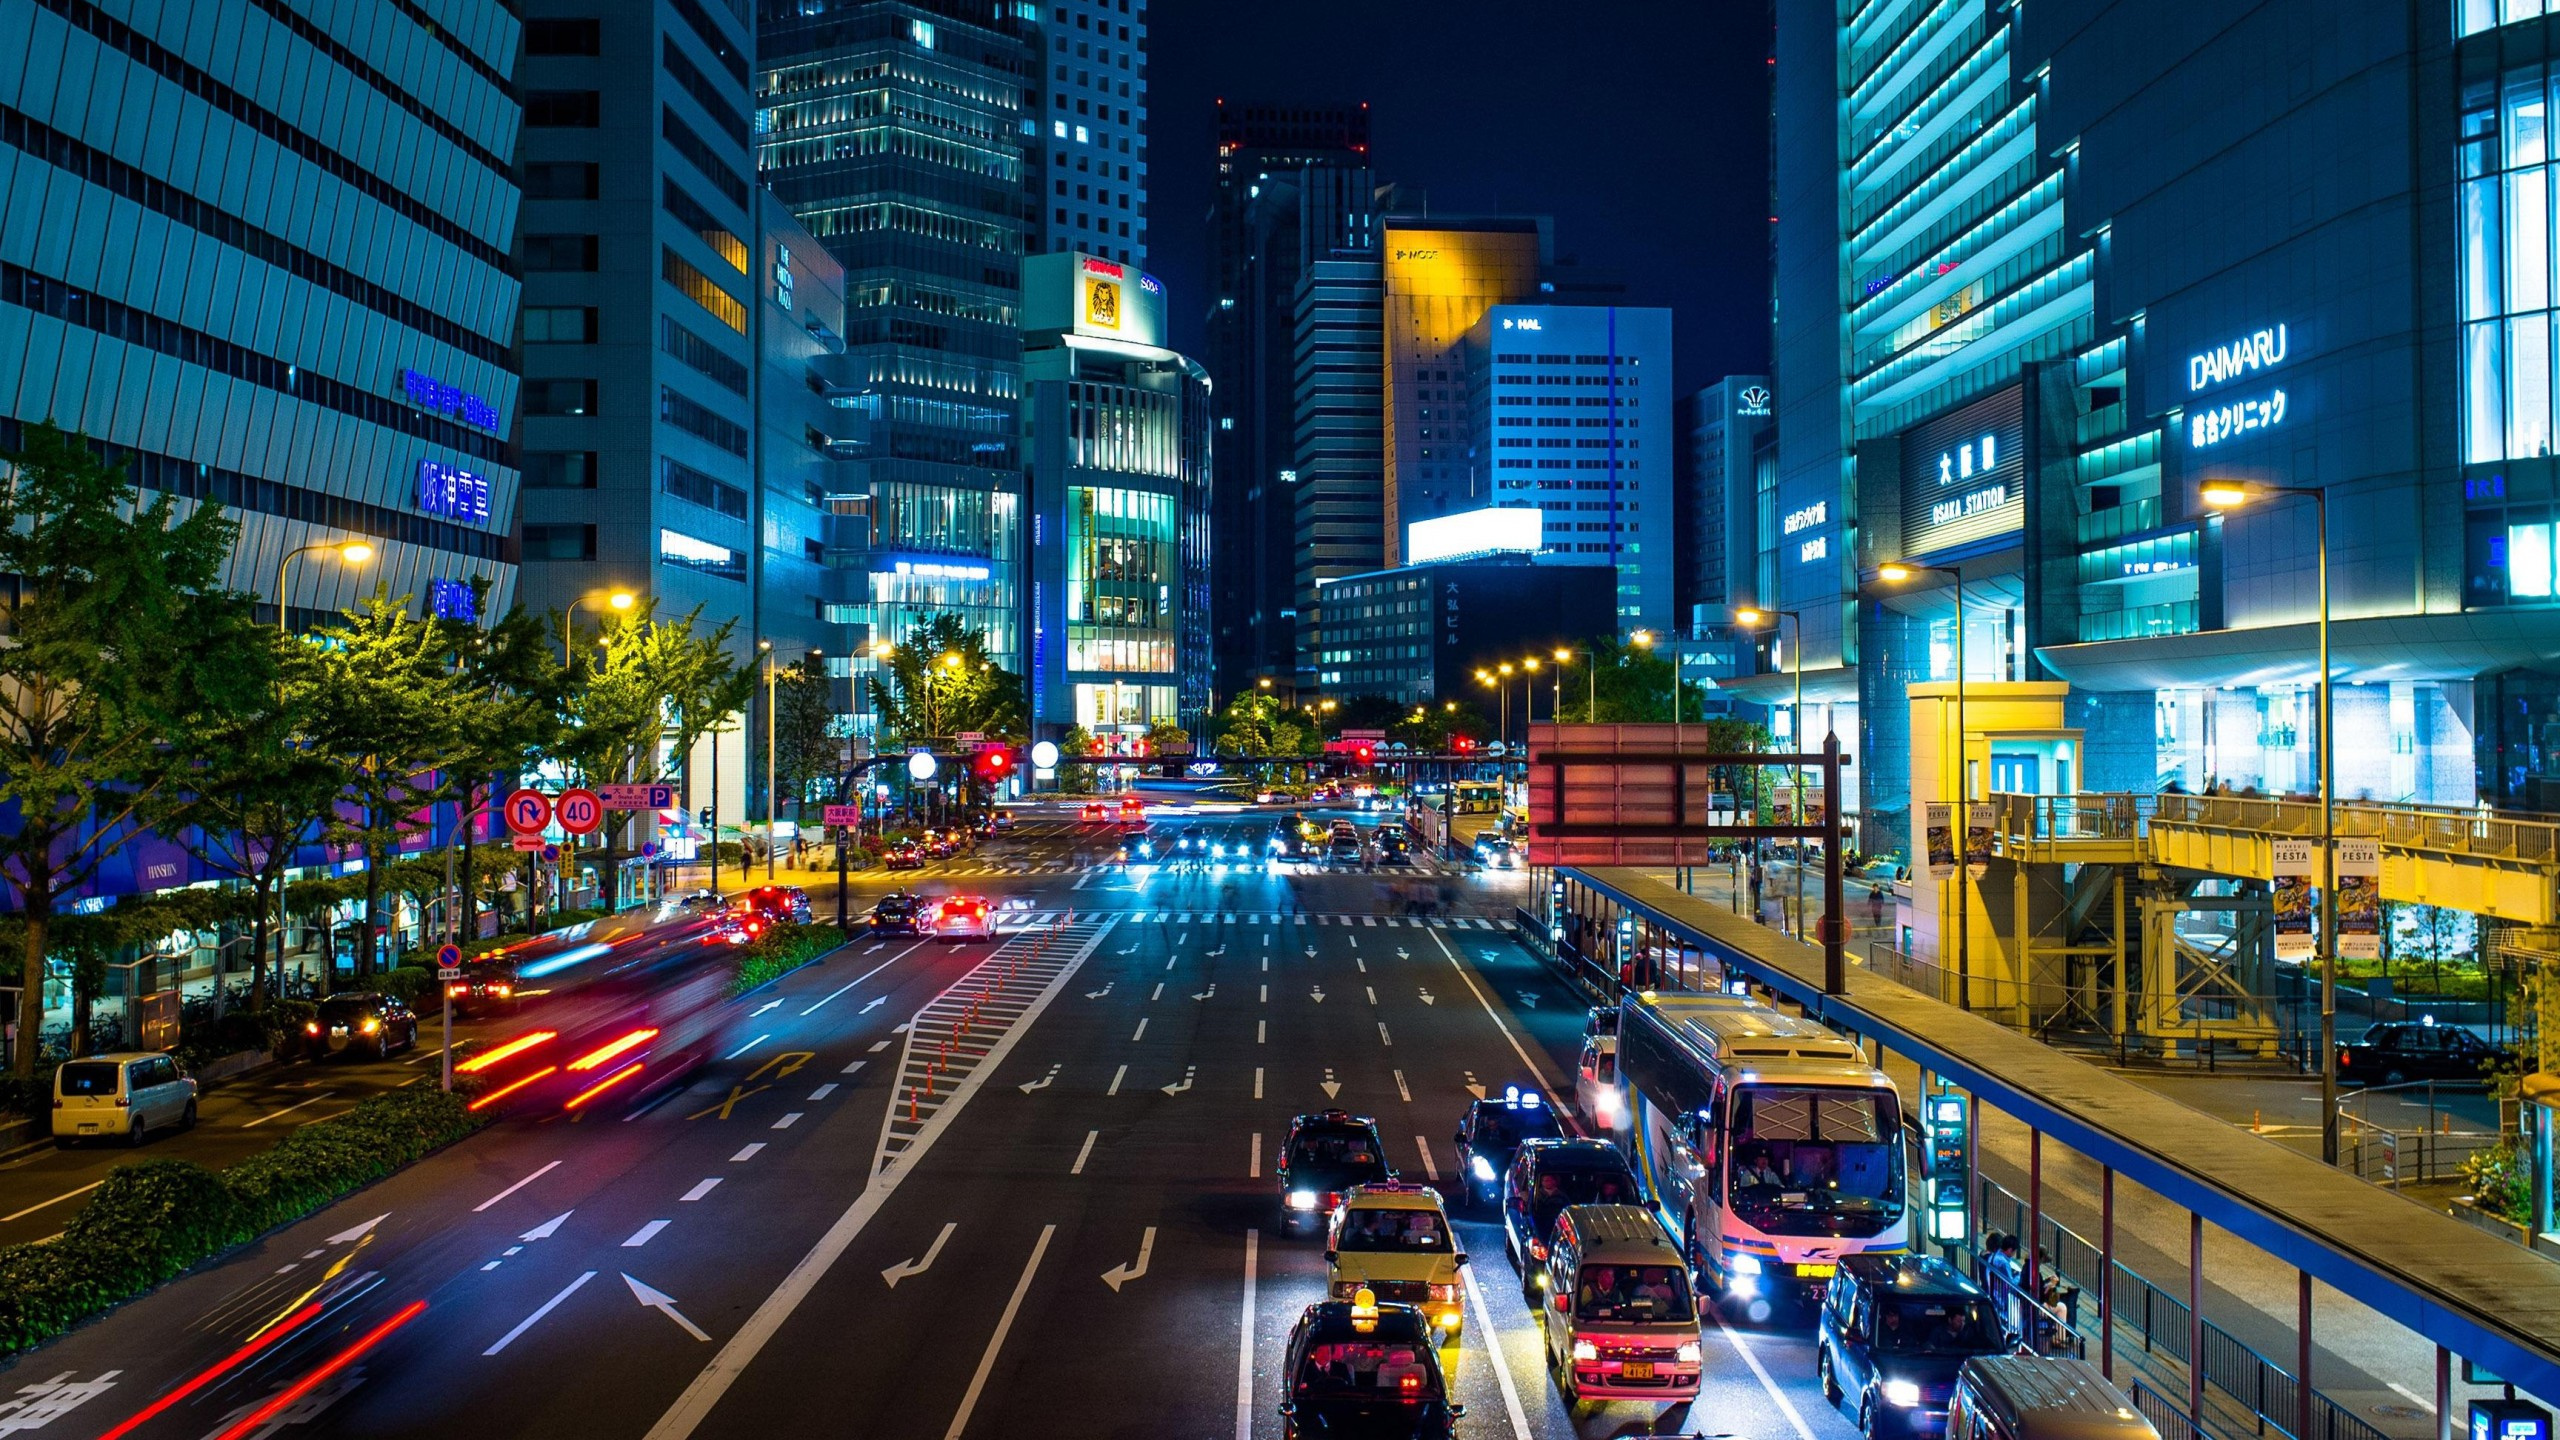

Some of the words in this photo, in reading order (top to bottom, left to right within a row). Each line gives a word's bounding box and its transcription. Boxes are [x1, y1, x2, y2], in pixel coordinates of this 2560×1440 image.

[1518, 318, 1542, 330] HAL
[2190, 323, 2286, 392] DAIMARU
[1933, 499, 1961, 525] OSAKA
[1966, 485, 2006, 514] STATION
[655, 790, 666, 806] P
[566, 802, 592, 822] 40
[2276, 852, 2307, 861] FESTA
[2342, 852, 2375, 861] FESTA
[147, 862, 177, 880] HANSHIN
